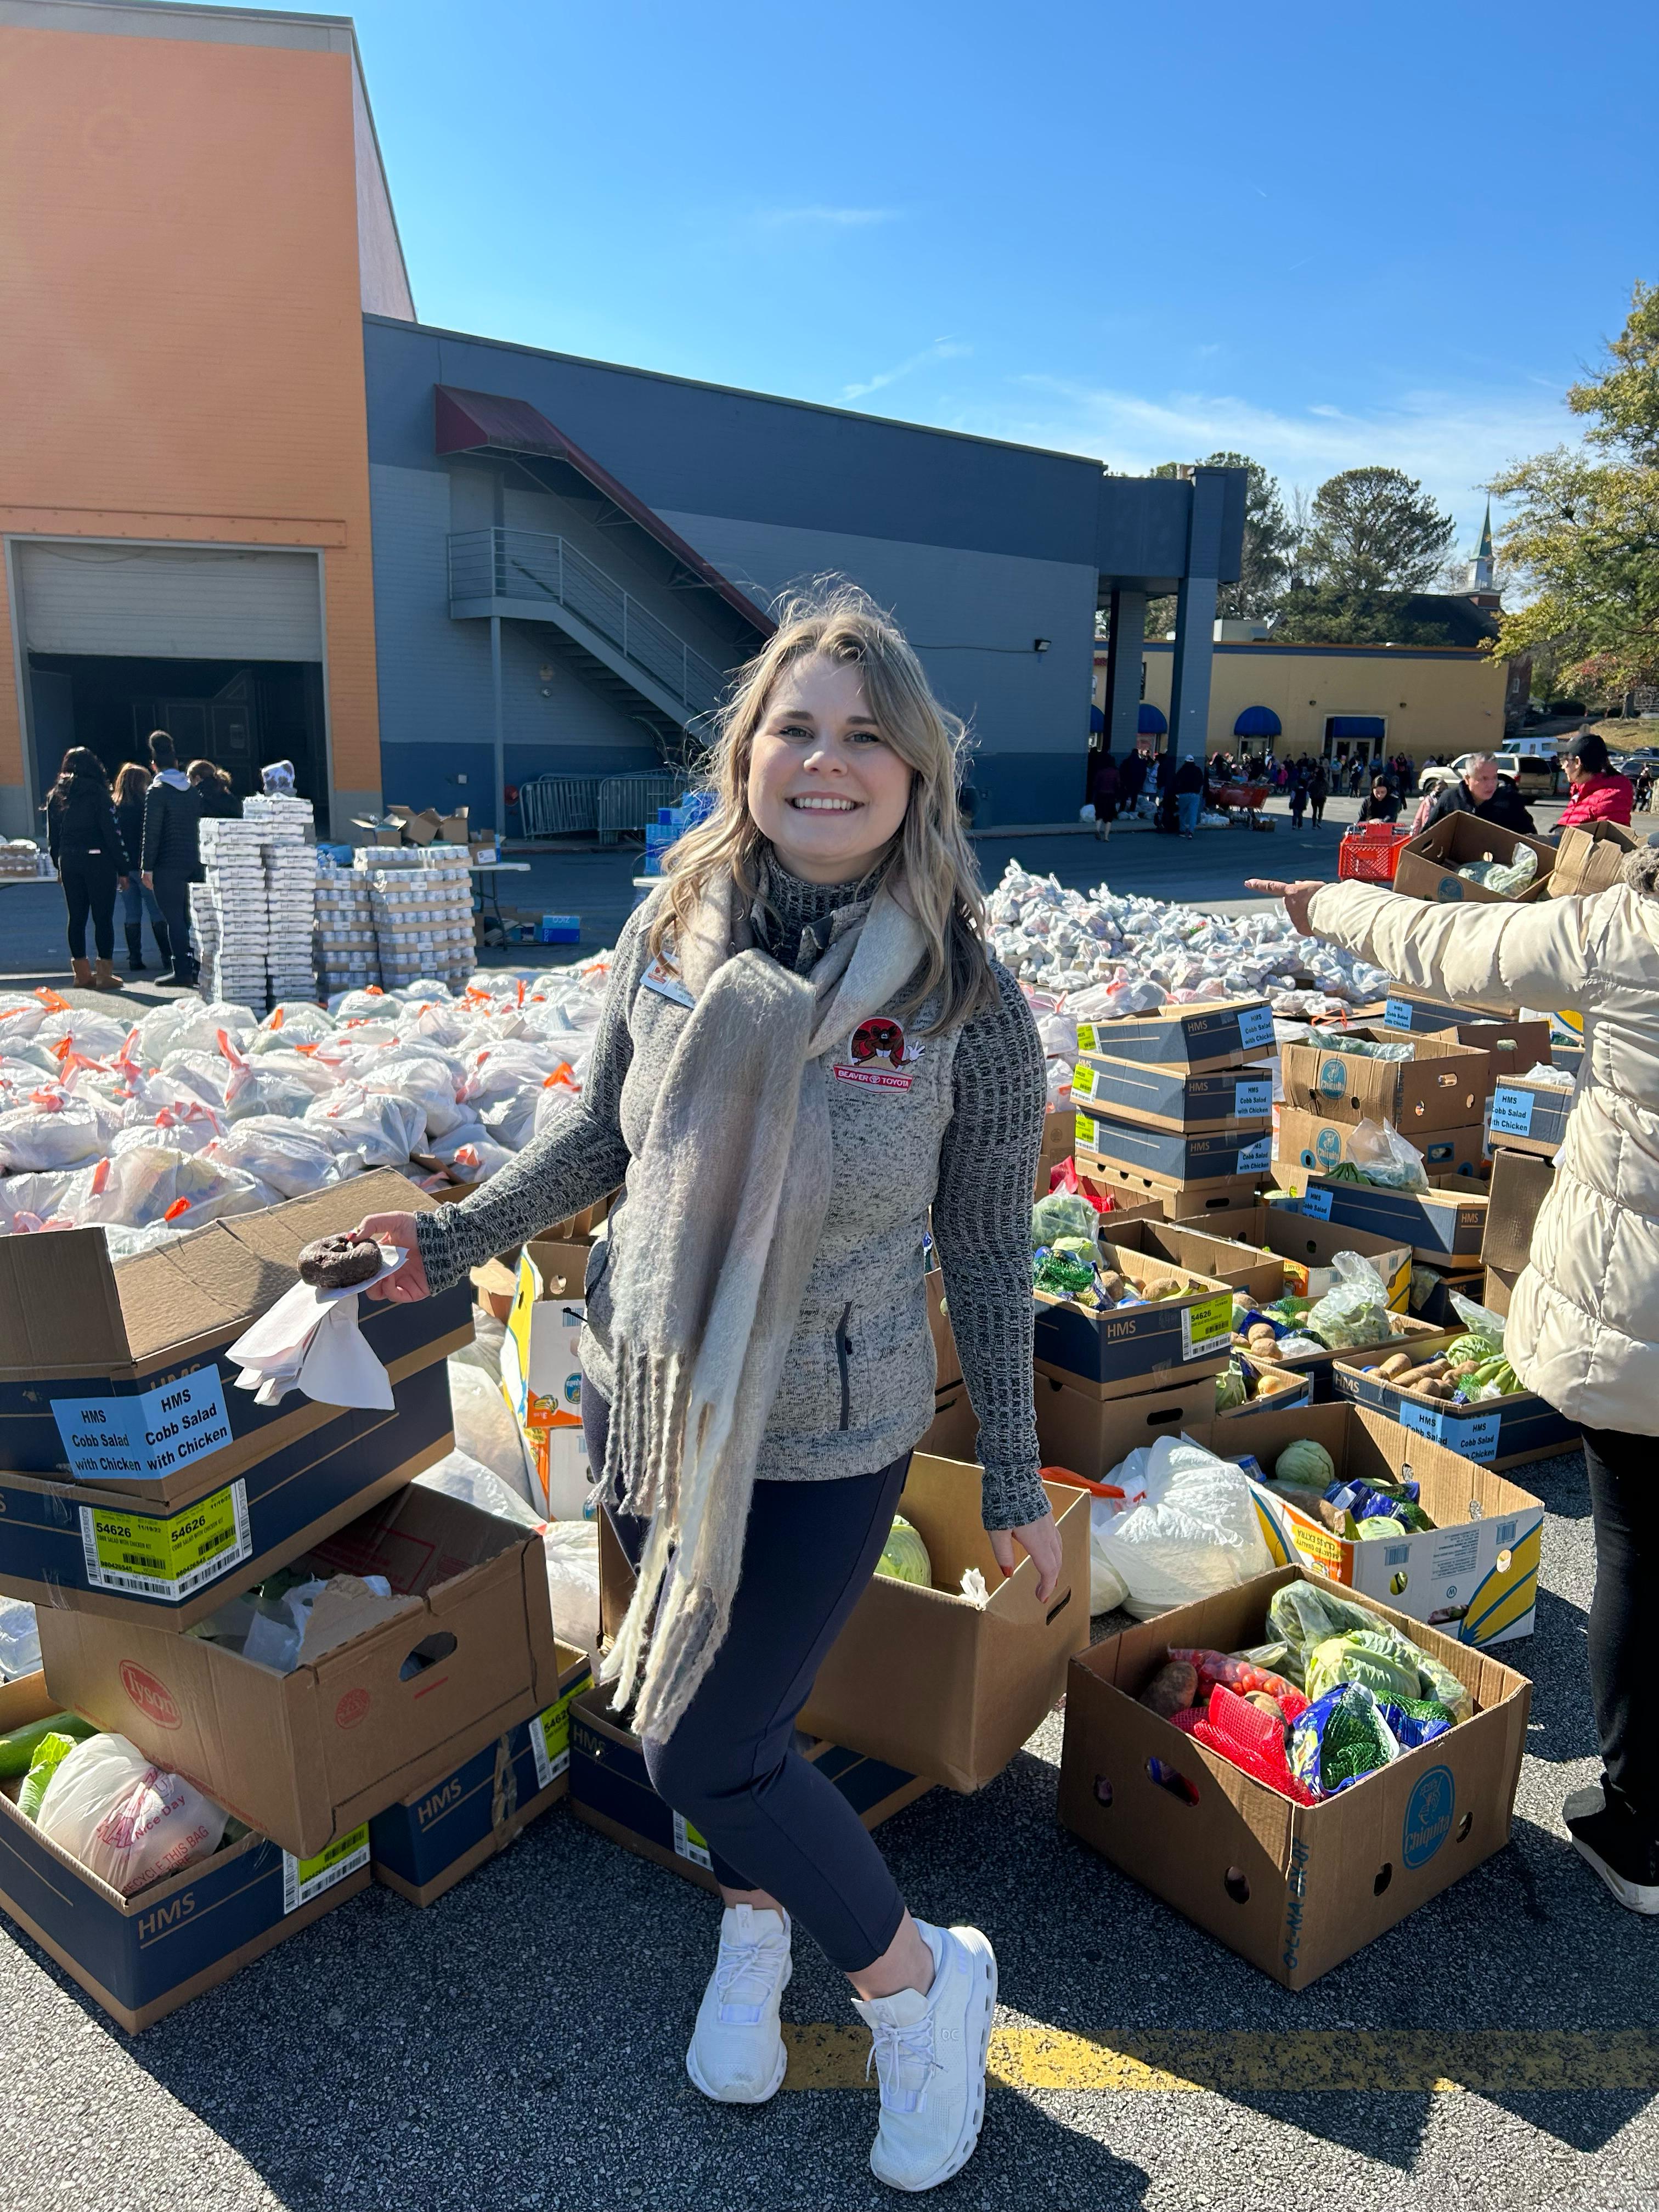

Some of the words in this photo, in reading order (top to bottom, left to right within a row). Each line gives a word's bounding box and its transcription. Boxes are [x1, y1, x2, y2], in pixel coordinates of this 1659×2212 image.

[1251, 1014, 1262, 1022] HMS
[1188, 1020, 1207, 1032] HMS
[1258, 1022, 1271, 1030] Salad
[1256, 1032, 1275, 1042] Chicken
[838, 1070, 868, 1081] BEAVER
[881, 1077, 909, 1087] TOYOTA
[1189, 1082, 1209, 1092] HMS
[1502, 1095, 1517, 1104] HMS
[1508, 1109, 1527, 1119] Salad
[1501, 1120, 1527, 1131] Chicken
[1190, 1141, 1210, 1152] HMS
[1310, 1193, 1321, 1201] HMS
[1314, 1205, 1327, 1214] Salad
[1461, 1213, 1479, 1223] HMS
[1107, 1320, 1136, 1338] HMS
[1334, 1373, 1359, 1393] HMS
[161, 1389, 191, 1413] HMS
[81, 1409, 107, 1424] HMS
[1419, 1414, 1436, 1427] HMS
[145, 1421, 179, 1446] Cobb
[182, 1403, 217, 1430] Salad
[1472, 1423, 1486, 1432] HMS
[72, 1434, 99, 1448] Cobb
[101, 1432, 130, 1447] Salad
[1426, 1431, 1448, 1446] Salad
[1460, 1438, 1476, 1448] Cobb
[1477, 1435, 1494, 1444] Salad
[146, 1451, 175, 1471] with
[177, 1426, 228, 1458] Chicken
[1471, 1448, 1494, 1460] Chicken
[75, 1458, 98, 1471] with
[99, 1457, 141, 1471] Chicken
[95, 1521, 131, 1538] 54626
[171, 1514, 205, 1542] 54626
[1297, 1529, 1316, 1543] EXTRA
[1296, 1539, 1314, 1551] QUALITY
[1317, 1537, 1335, 1550] CLASS
[126, 1668, 177, 1718] Tyson
[417, 1778, 462, 1825] HMS
[135, 1816, 161, 1839] Nice
[161, 1795, 186, 1816] Day
[1404, 1815, 1450, 1854] Chiquita
[122, 1861, 163, 1894] RECYCLE
[163, 1843, 188, 1864] THIS
[187, 1825, 210, 1847] BAG
[138, 1892, 196, 1940] HMS
